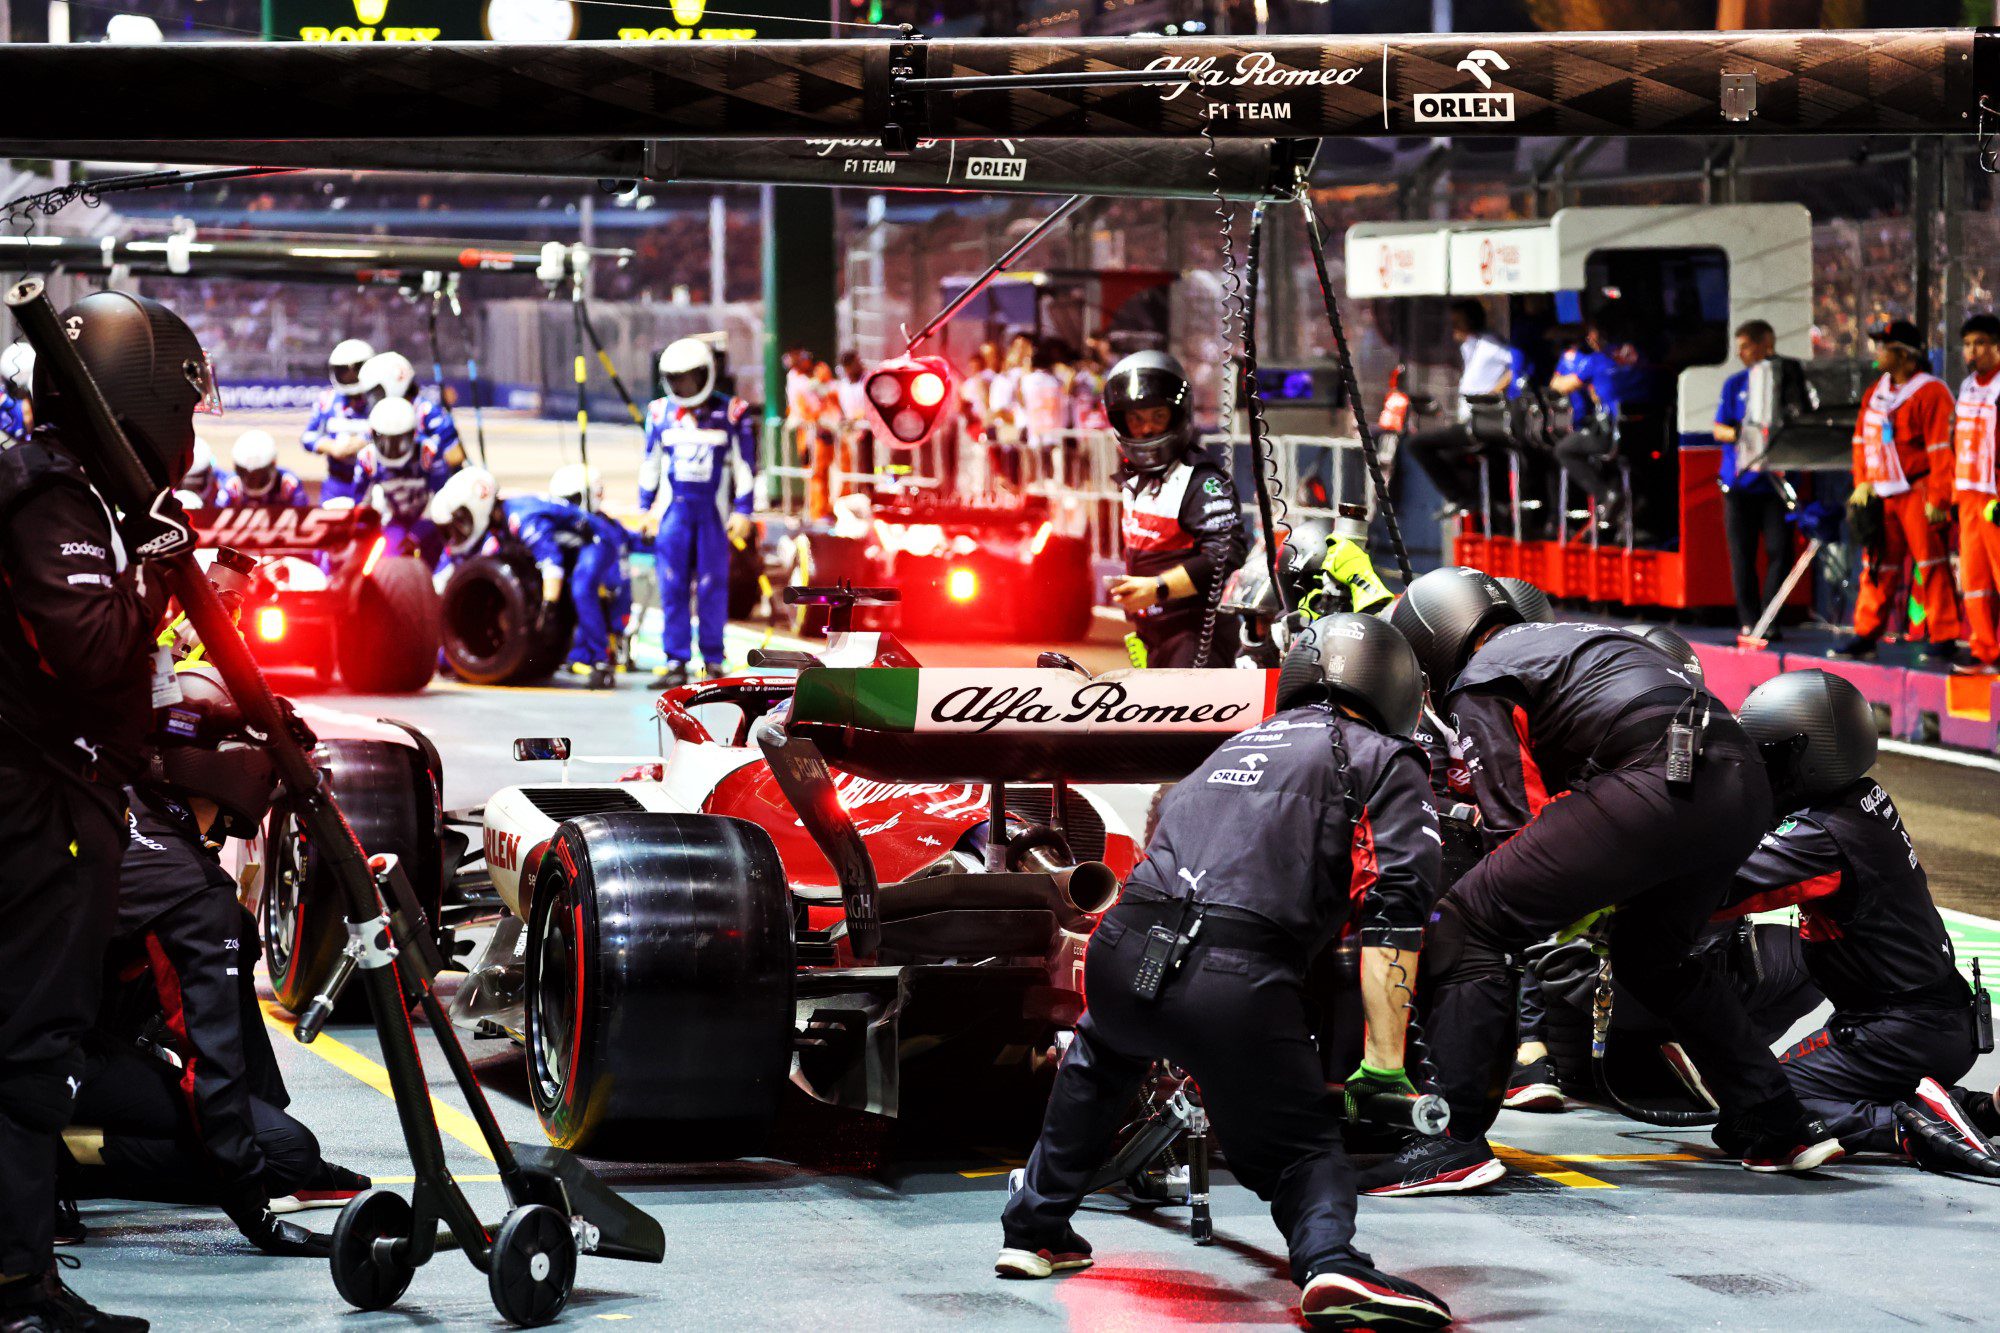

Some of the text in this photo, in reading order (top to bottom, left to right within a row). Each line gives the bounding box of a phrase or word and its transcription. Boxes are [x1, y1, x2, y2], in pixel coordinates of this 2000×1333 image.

[1142, 52, 1363, 100] Alfa Romeo
[1208, 103, 1291, 119] F1 TEAM
[1419, 98, 1508, 118] ORLEN
[844, 159, 896, 174] F1 TEAM
[970, 161, 1022, 177] ORLEN
[198, 508, 350, 545] HAAS
[931, 682, 1250, 734] Alfa Romeo
[1253, 733, 1284, 742] TEAM
[1213, 772, 1258, 783] ORLEN
[483, 826, 521, 872] RLEN
[1795, 1031, 1830, 1058] PIT
